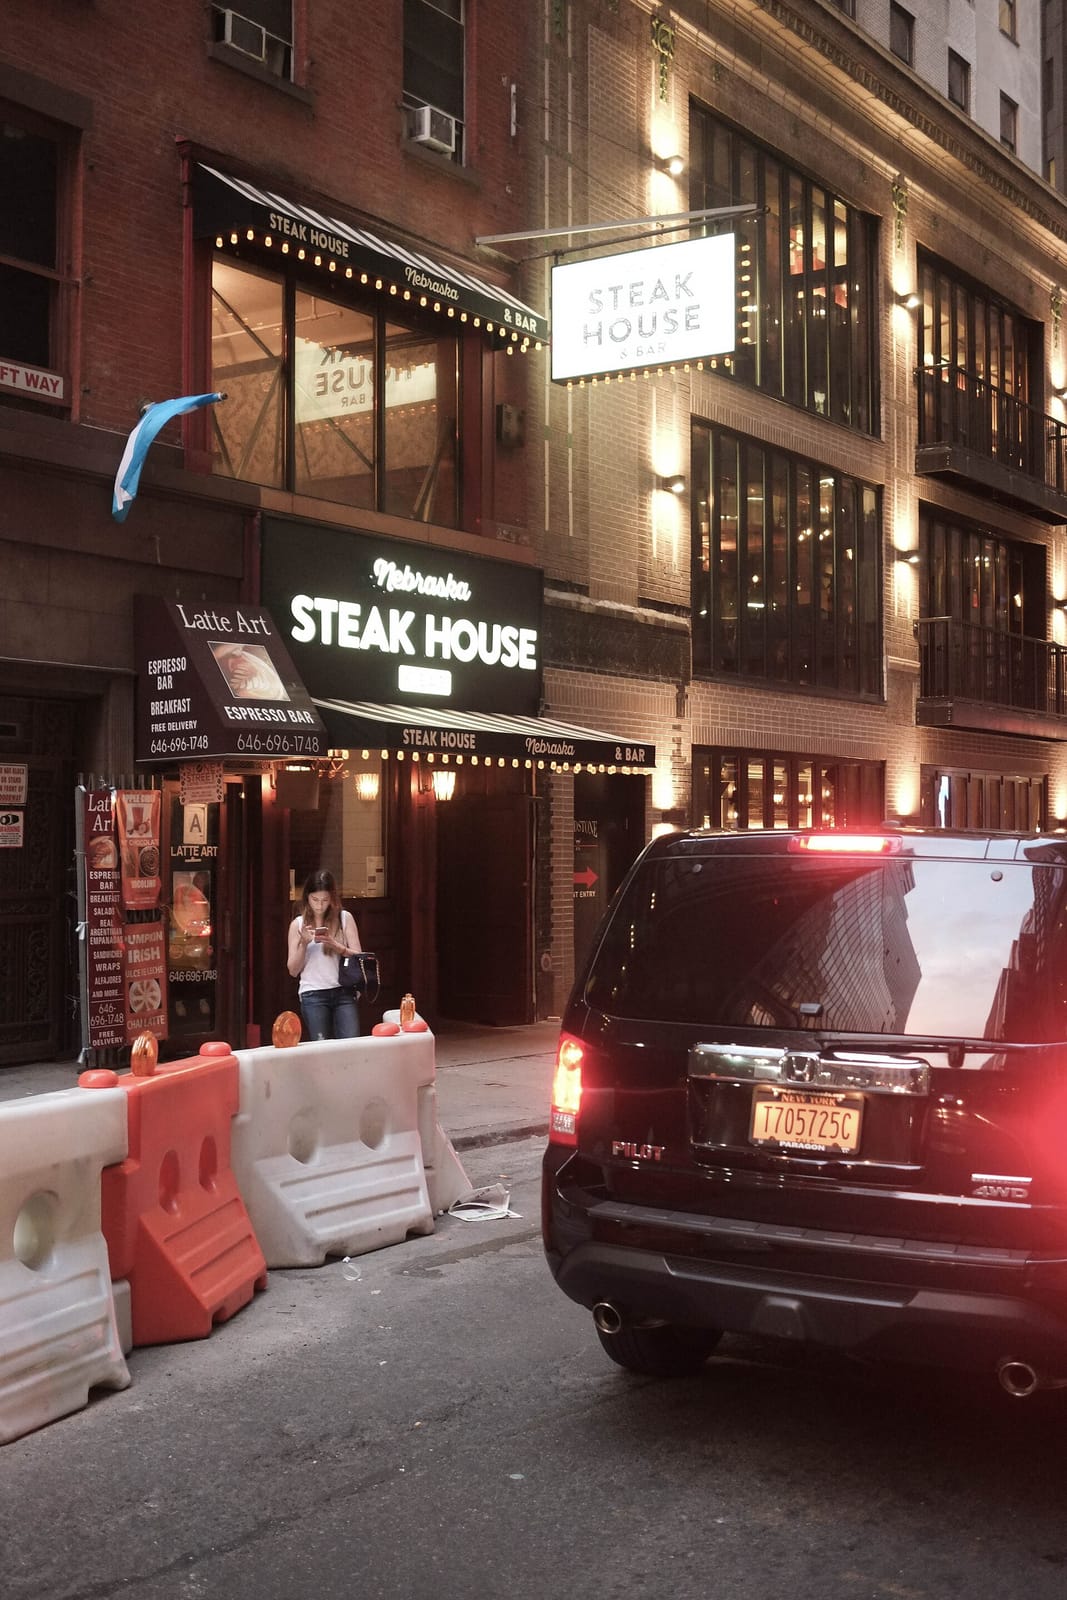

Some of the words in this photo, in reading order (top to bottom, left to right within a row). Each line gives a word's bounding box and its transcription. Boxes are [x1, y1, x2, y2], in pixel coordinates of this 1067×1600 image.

[270, 213, 307, 241] STEAK
[310, 229, 349, 258] HOUSE
[405, 266, 459, 300] Nebraska
[588, 272, 694, 315] STEAK
[504, 308, 512, 323] &
[515, 312, 536, 333] BAR
[583, 304, 700, 346] HOUSE
[636, 342, 666, 358] BAR
[25, 372, 60, 393] WAY
[373, 557, 472, 601] Nebraska
[176, 604, 232, 632] Latte
[237, 610, 272, 636] Art
[290, 594, 416, 656] STEAK
[425, 613, 537, 670] HOUSE
[148, 656, 186, 676] ESPRESSO
[157, 675, 173, 691] BAR
[150, 698, 191, 716] BREAKFAST
[224, 705, 286, 722] ESPRESSO
[289, 708, 314, 724] BAR
[151, 723, 166, 733] FREE
[168, 720, 197, 732] DELIVERY
[150, 735, 208, 754] 646-696-1748
[237, 734, 319, 752] 646-696-1748
[403, 728, 437, 746] STEAK
[440, 731, 476, 749] HOUSE
[525, 737, 575, 756] Nebraska
[615, 747, 623, 760] &
[626, 748, 645, 762] BAR
[186, 773, 214, 782] STREET
[88, 794, 112, 812] Lat
[92, 814, 113, 832] Ar
[190, 814, 202, 833] A
[170, 846, 199, 857] LATTE
[201, 846, 218, 857] ART
[100, 882, 114, 890] BAR
[128, 946, 160, 964] IRISH
[95, 962, 121, 972] WRAPS
[169, 970, 218, 982] 646-696-1748
[95, 975, 121, 985] ALFAJORES
[92, 990, 103, 998] AND
[90, 1013, 124, 1026] 696-1748
[127, 1018, 142, 1030] CHAI
[144, 1015, 165, 1027] LATTE
[92, 1037, 123, 1046] DELIVERY
[99, 1030, 114, 1038] FREE
[781, 1094, 805, 1104] NEW
[810, 1097, 836, 1106] YORK
[764, 1105, 852, 1140] T705725C
[612, 1141, 665, 1160] PILOT
[779, 1141, 825, 1151] PARAGON
[972, 1185, 1029, 1198] 4WD
